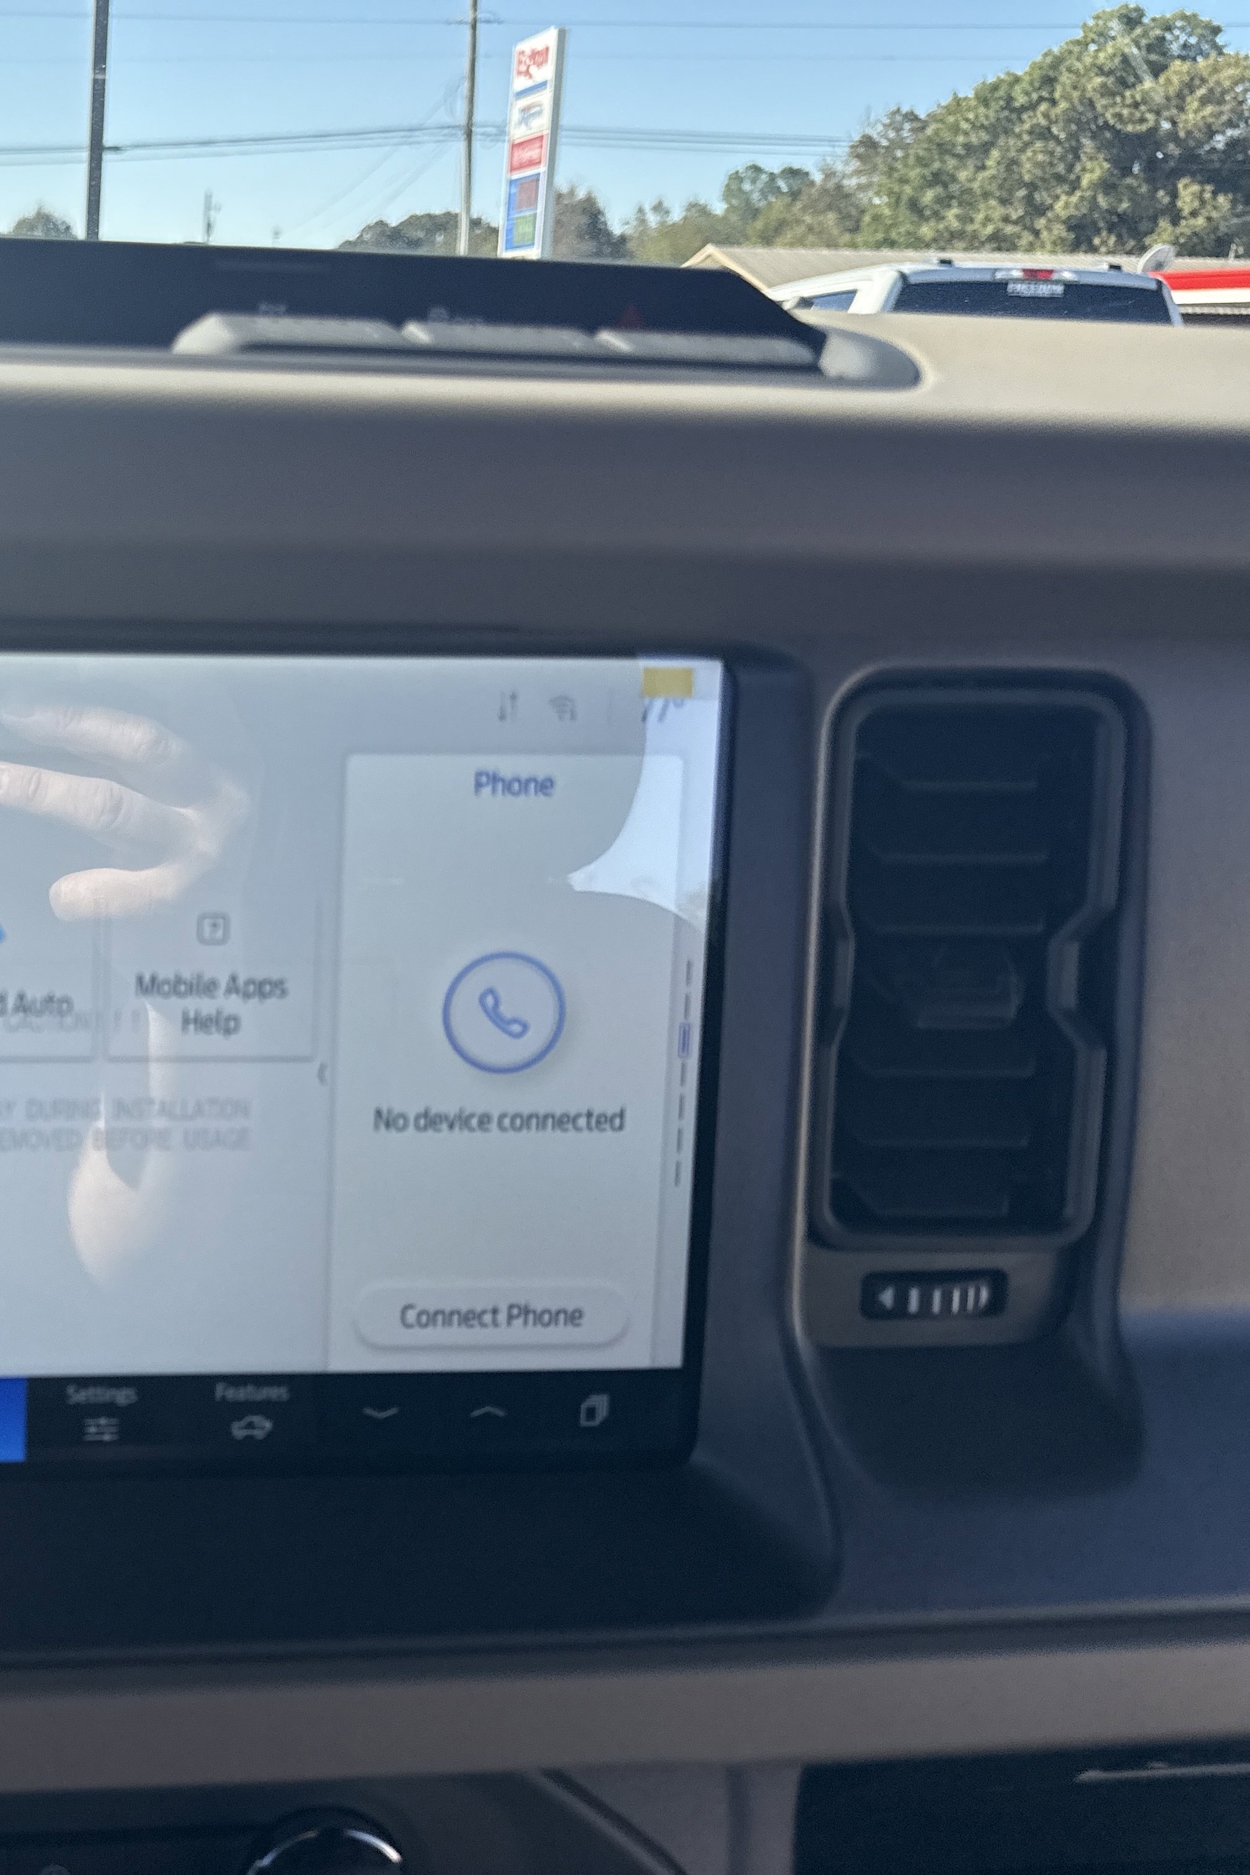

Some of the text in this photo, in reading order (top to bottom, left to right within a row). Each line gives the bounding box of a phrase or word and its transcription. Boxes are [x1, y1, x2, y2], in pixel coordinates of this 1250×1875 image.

[474, 770, 555, 797] Phone
[135, 972, 289, 1002] Mobile Apps
[11, 989, 74, 1018] Auto
[181, 1008, 241, 1037] Help
[25, 1097, 101, 1122] DURING
[111, 1097, 251, 1121] INSTALLATION
[373, 1106, 626, 1133] No device connected
[92, 1127, 171, 1152] BEFORE
[182, 1127, 251, 1152] USAGE
[399, 1303, 584, 1330] Connect Phone
[66, 1384, 137, 1405] Settings
[215, 1382, 289, 1402] Features
